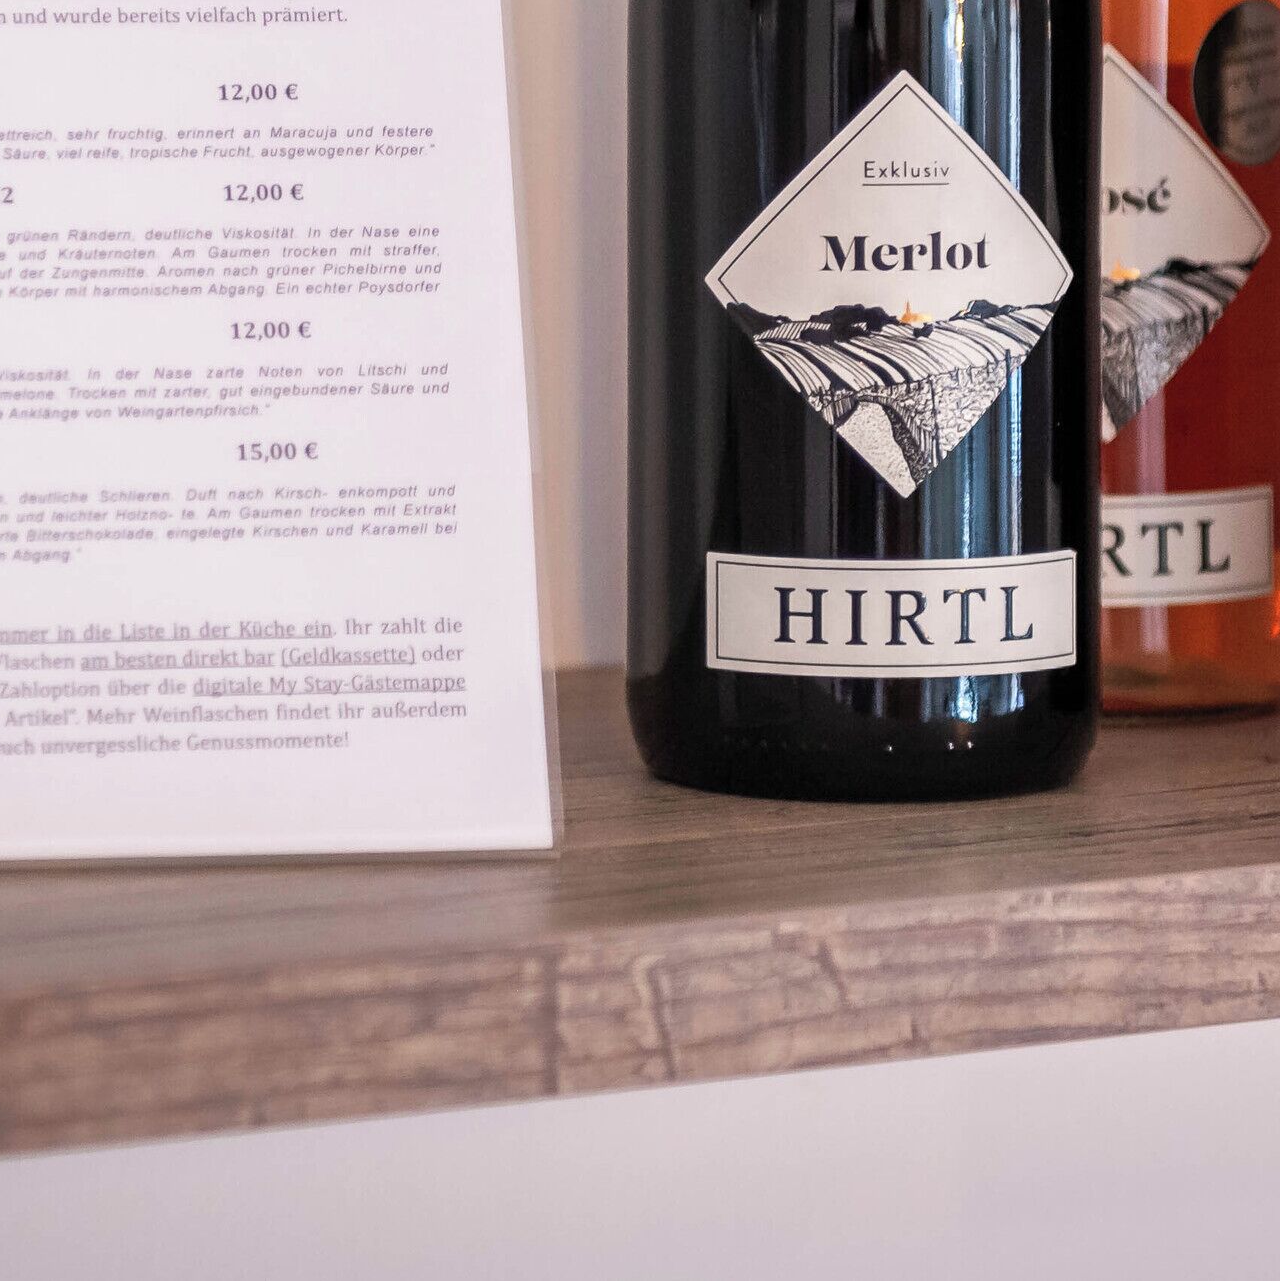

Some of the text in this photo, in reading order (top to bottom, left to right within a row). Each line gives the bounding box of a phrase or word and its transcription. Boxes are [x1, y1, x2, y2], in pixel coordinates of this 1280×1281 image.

[12, 8, 47, 24] und
[53, 8, 111, 24] wurde
[117, 8, 180, 24] bereits
[185, 6, 256, 23] vielfach
[262, 8, 347, 25] prämiert.
[218, 83, 298, 101] 12,00 €
[67, 130, 99, 141] sehr
[176, 128, 235, 139] erinnert
[242, 129, 261, 139] an
[269, 126, 338, 140] Maracuja
[345, 126, 374, 138] und
[381, 126, 434, 138] festere
[129, 147, 198, 159] tropische
[260, 146, 370, 160] ausgewogener
[863, 160, 951, 181] Exklusiv
[224, 183, 304, 202] 12,00 €
[307, 226, 440, 238] In der Nase eine
[171, 247, 195, 259] Am
[207, 246, 270, 259] Gaumen
[281, 246, 337, 257] trocken
[349, 245, 372, 257] mit
[820, 231, 992, 272] Merlot
[157, 263, 443, 278] Aromen nach grüner Pichelbirne und
[275, 280, 441, 294] Ein echter Poysdorfer
[231, 321, 311, 340] 12,00 €
[153, 363, 449, 379] Nase zarte Noten von Litschi und
[69, 386, 127, 399] Trocken
[134, 387, 157, 398] mit
[218, 386, 243, 400] gut
[249, 384, 363, 398] eingebundener
[369, 382, 415, 395] Säure
[421, 382, 450, 394] und
[237, 441, 318, 461] 15,00 €
[185, 488, 218, 501] Duft
[227, 488, 264, 501] nach
[337, 486, 418, 498] enkompott
[427, 485, 457, 497] und
[207, 503, 457, 519] Am Gaumen trocken mit Extrakt
[251, 522, 458, 538] Kirschen und Karamell bei
[773, 584, 1035, 648] HIRTL
[198, 621, 230, 641] der
[238, 620, 296, 640] Küche
[345, 618, 372, 635] Ihr
[380, 617, 426, 634] zahlt
[433, 616, 462, 633] die
[181, 644, 464, 669] direkt bar (Geldkassette) oder
[107, 674, 466, 697] über die digitale My Stay-Gästemappe
[276, 701, 467, 720] findet ihr außerdem
[186, 733, 349, 749] Genussmomente!
